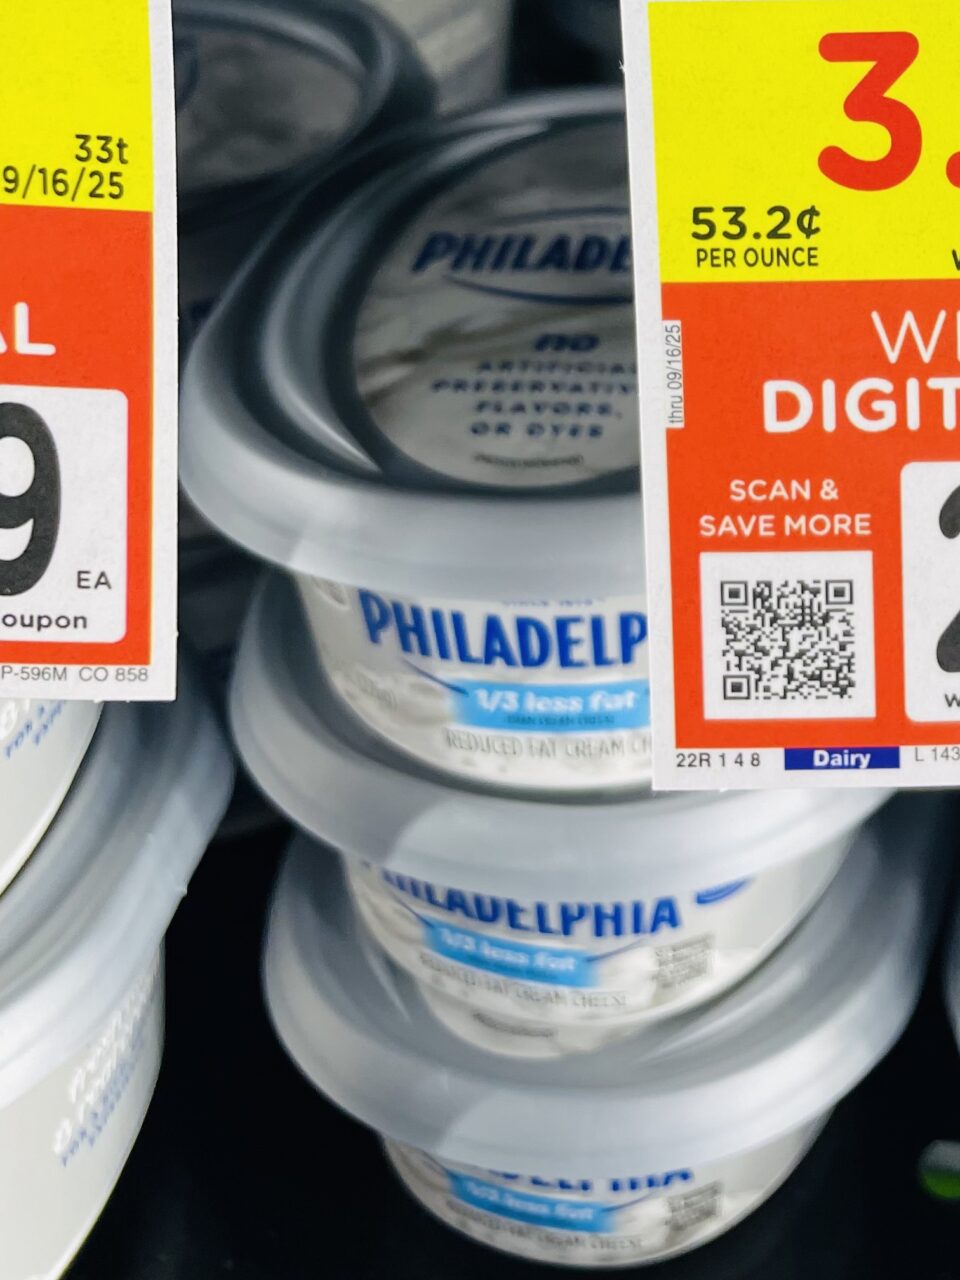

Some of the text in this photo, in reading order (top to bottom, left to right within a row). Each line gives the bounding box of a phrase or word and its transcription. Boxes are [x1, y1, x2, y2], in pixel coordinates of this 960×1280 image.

[74, 134, 129, 165] 33t
[2, 164, 125, 202] 9/16/25
[690, 204, 822, 242] 53.2¢
[695, 246, 820, 269] PER OUNCE
[0, 300, 57, 356] L
[664, 323, 684, 424] thru 09/16/25
[728, 478, 840, 503] SCAN &
[698, 513, 872, 538] SAVE MORE
[77, 570, 112, 590] EA
[2, 613, 87, 632] oupon
[1, 665, 148, 682] P-596M CO 858
[473, 688, 637, 714] 1/3 less fat
[675, 753, 712, 768] 22R
[812, 749, 871, 769] Dairy
[914, 747, 925, 762] L
